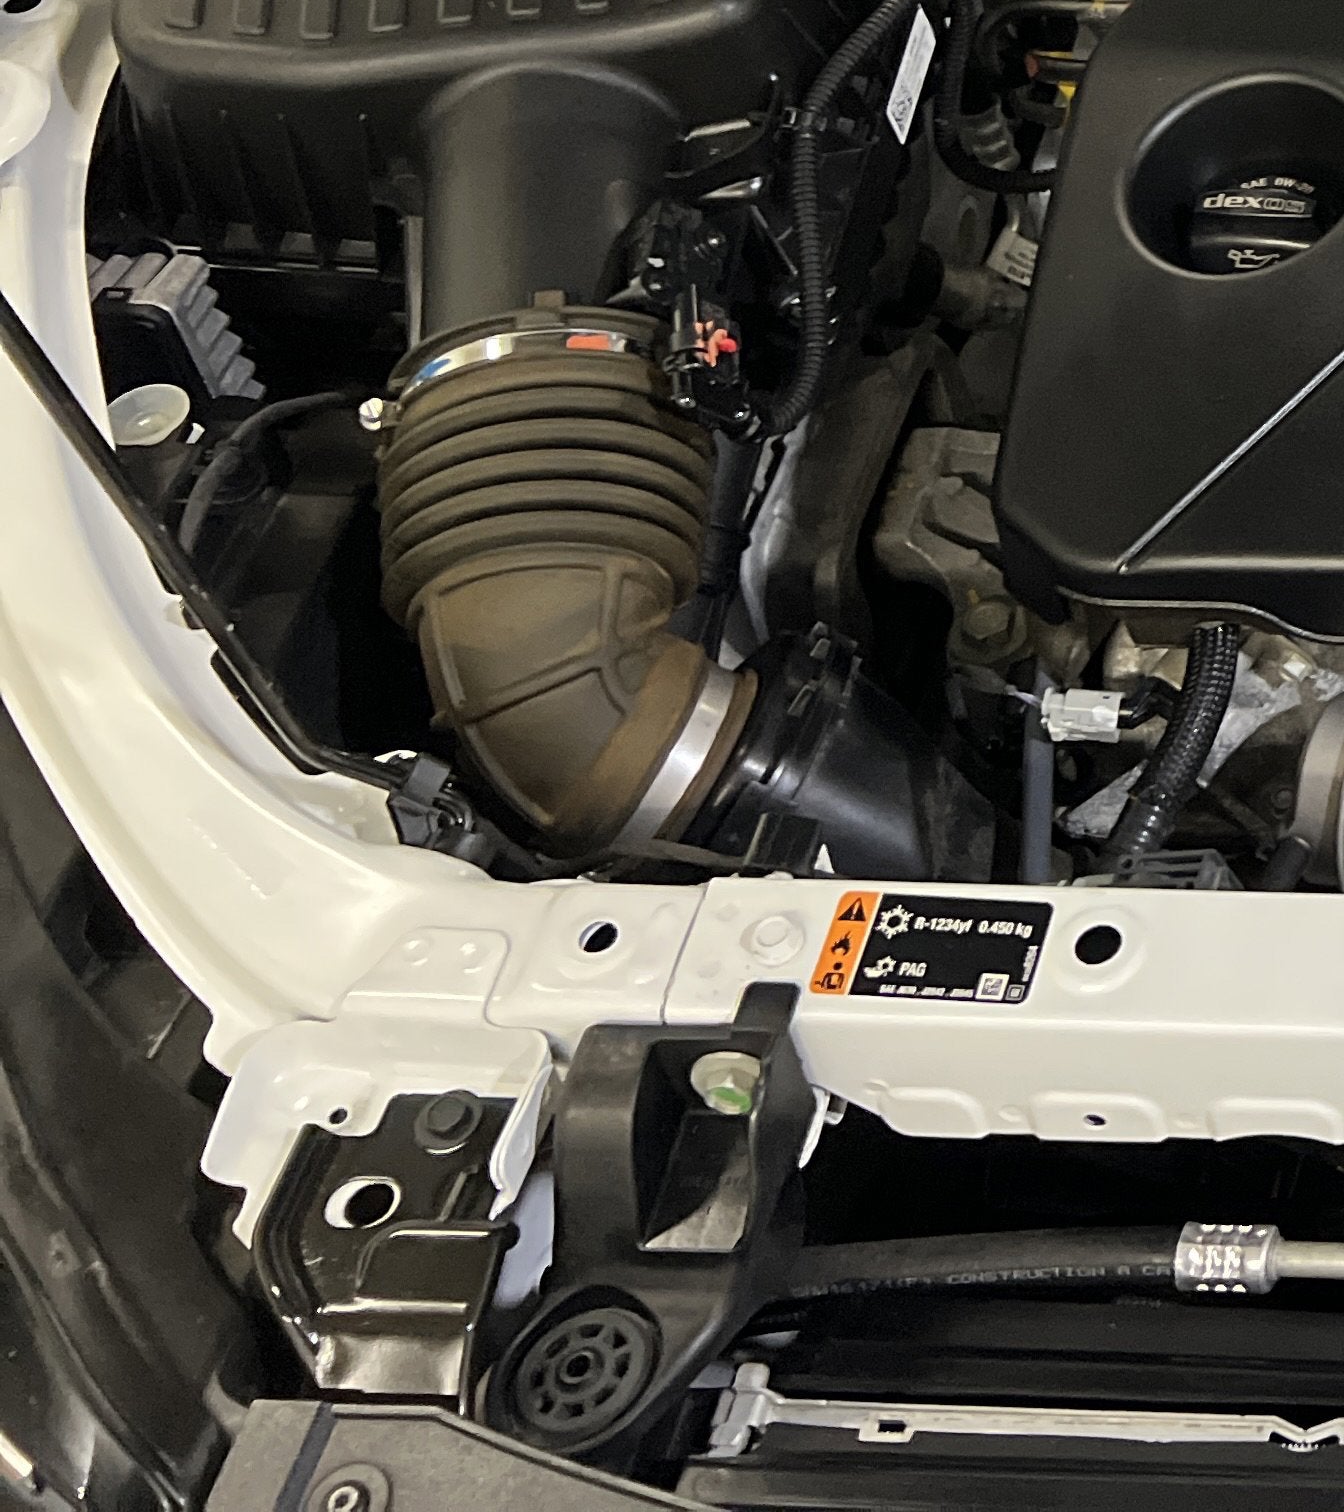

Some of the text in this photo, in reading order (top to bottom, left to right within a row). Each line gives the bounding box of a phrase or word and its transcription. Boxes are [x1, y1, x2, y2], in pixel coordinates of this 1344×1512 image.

[1203, 192, 1306, 214] dexos
[913, 917, 1034, 940] R-1234yf 0.450 kg
[899, 962, 927, 977] PAG
[946, 1266, 1106, 1285] CONSTRUCTION
